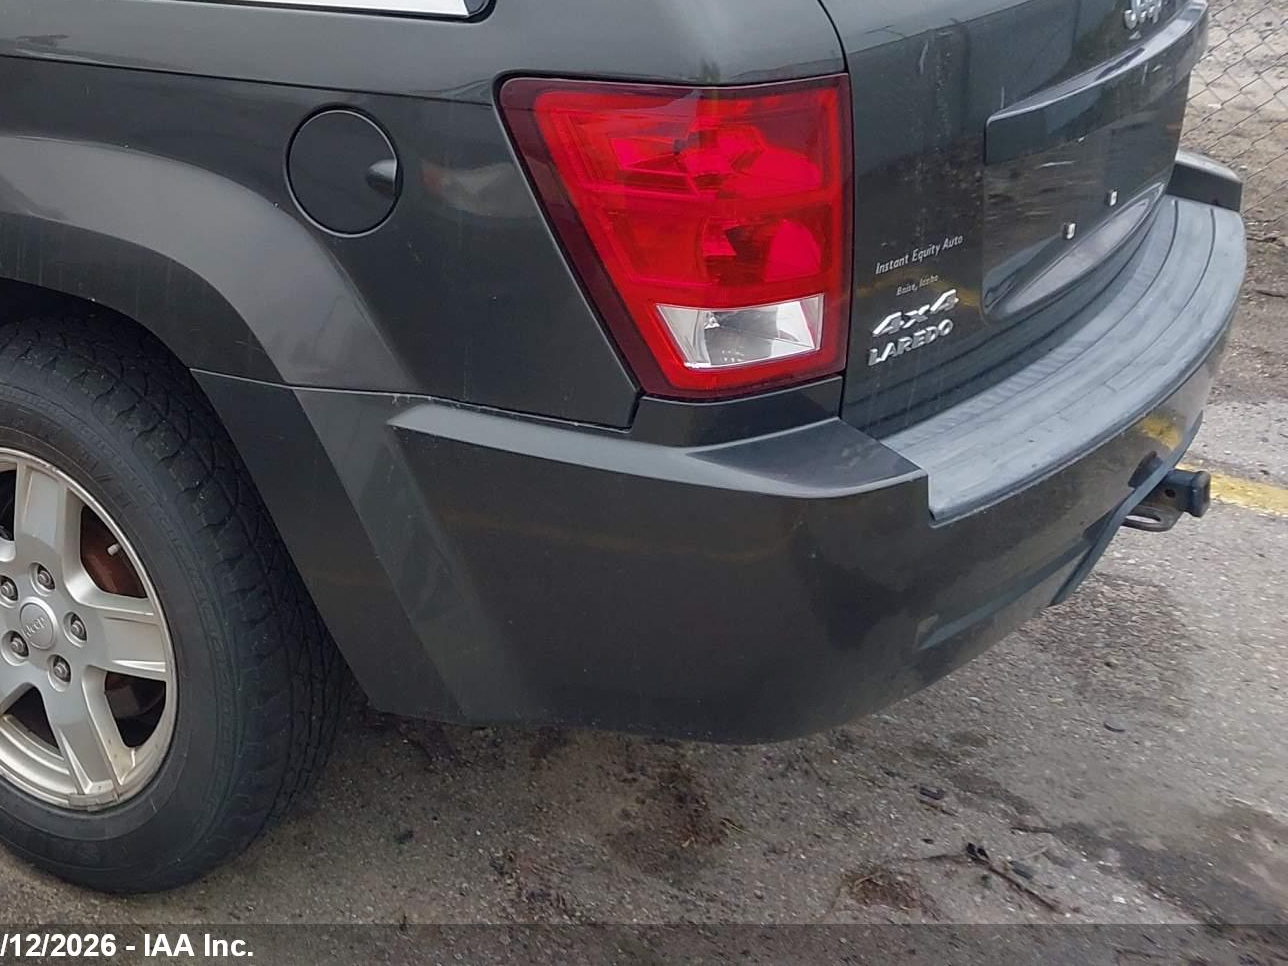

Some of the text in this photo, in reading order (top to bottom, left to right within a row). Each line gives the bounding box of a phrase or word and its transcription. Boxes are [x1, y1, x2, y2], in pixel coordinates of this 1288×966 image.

[876, 235, 964, 274] Instant Equity Auto
[868, 319, 954, 366] LAREDO
